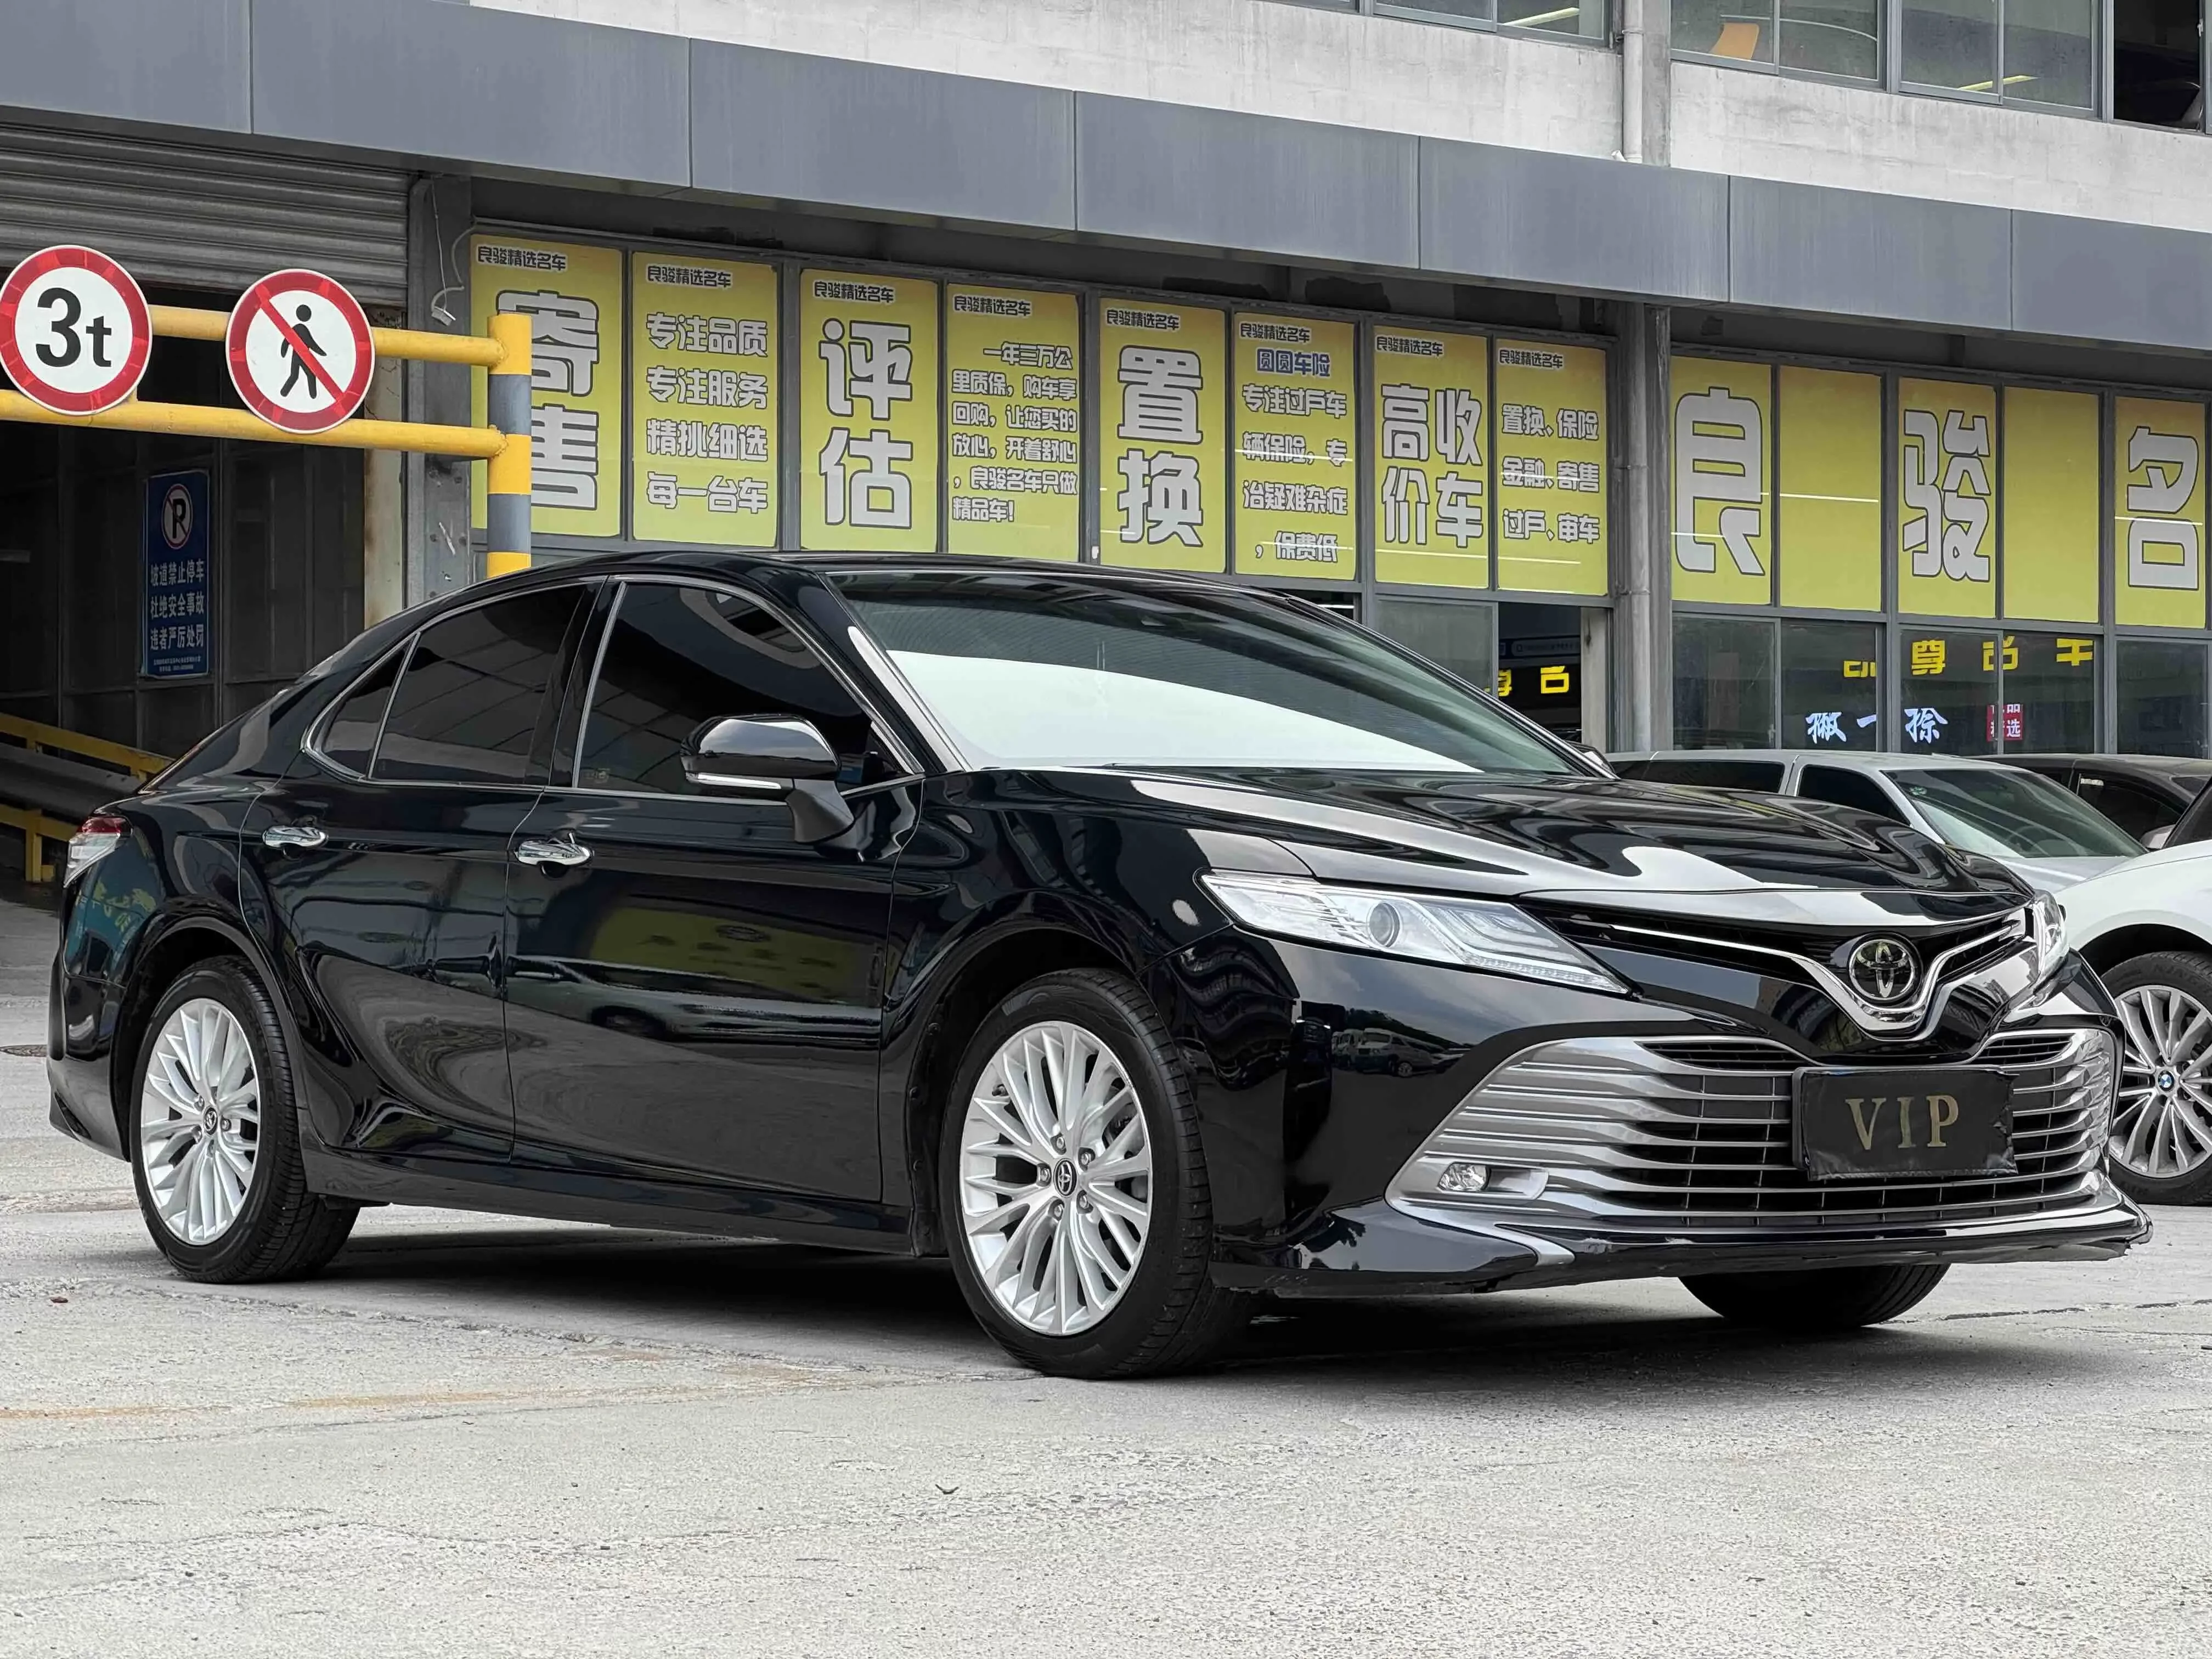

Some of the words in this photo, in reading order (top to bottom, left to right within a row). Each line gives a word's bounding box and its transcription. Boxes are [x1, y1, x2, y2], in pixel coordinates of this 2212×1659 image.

[476, 245, 567, 272] 良骏精选名车
[647, 266, 731, 288] 良骏精选名车
[814, 281, 894, 303] 良骏精选名车
[953, 295, 1031, 317] 良骏精选名车
[36, 287, 112, 368] 3t
[1106, 309, 1180, 330] 良骏精选名车
[1240, 323, 1310, 343] 良骏精选名车
[646, 312, 768, 358] 专注品质
[1376, 336, 1443, 357] 良骏精选名车
[983, 342, 1073, 370] 一年三万公
[1256, 348, 1331, 377] 圆圆车险
[1499, 349, 1563, 368] 良骏精选名车
[646, 366, 768, 409] 专注服务
[1243, 384, 1347, 419] 专注过户车
[819, 318, 913, 529] 评估
[646, 418, 768, 461] 精挑细选
[1117, 345, 1203, 546] 置换
[646, 471, 768, 514] 每一台车
[1243, 480, 1348, 515] 治疑难杂症
[1674, 387, 1765, 575] 良
[1903, 410, 1990, 582] 骏
[2127, 426, 2199, 591] 名
[150, 558, 204, 586] 坡道禁止停车
[150, 590, 204, 620] 杜绝安全事故
[150, 624, 204, 651] 违者严厉处罚
[1845, 1095, 1959, 1150] VIP
